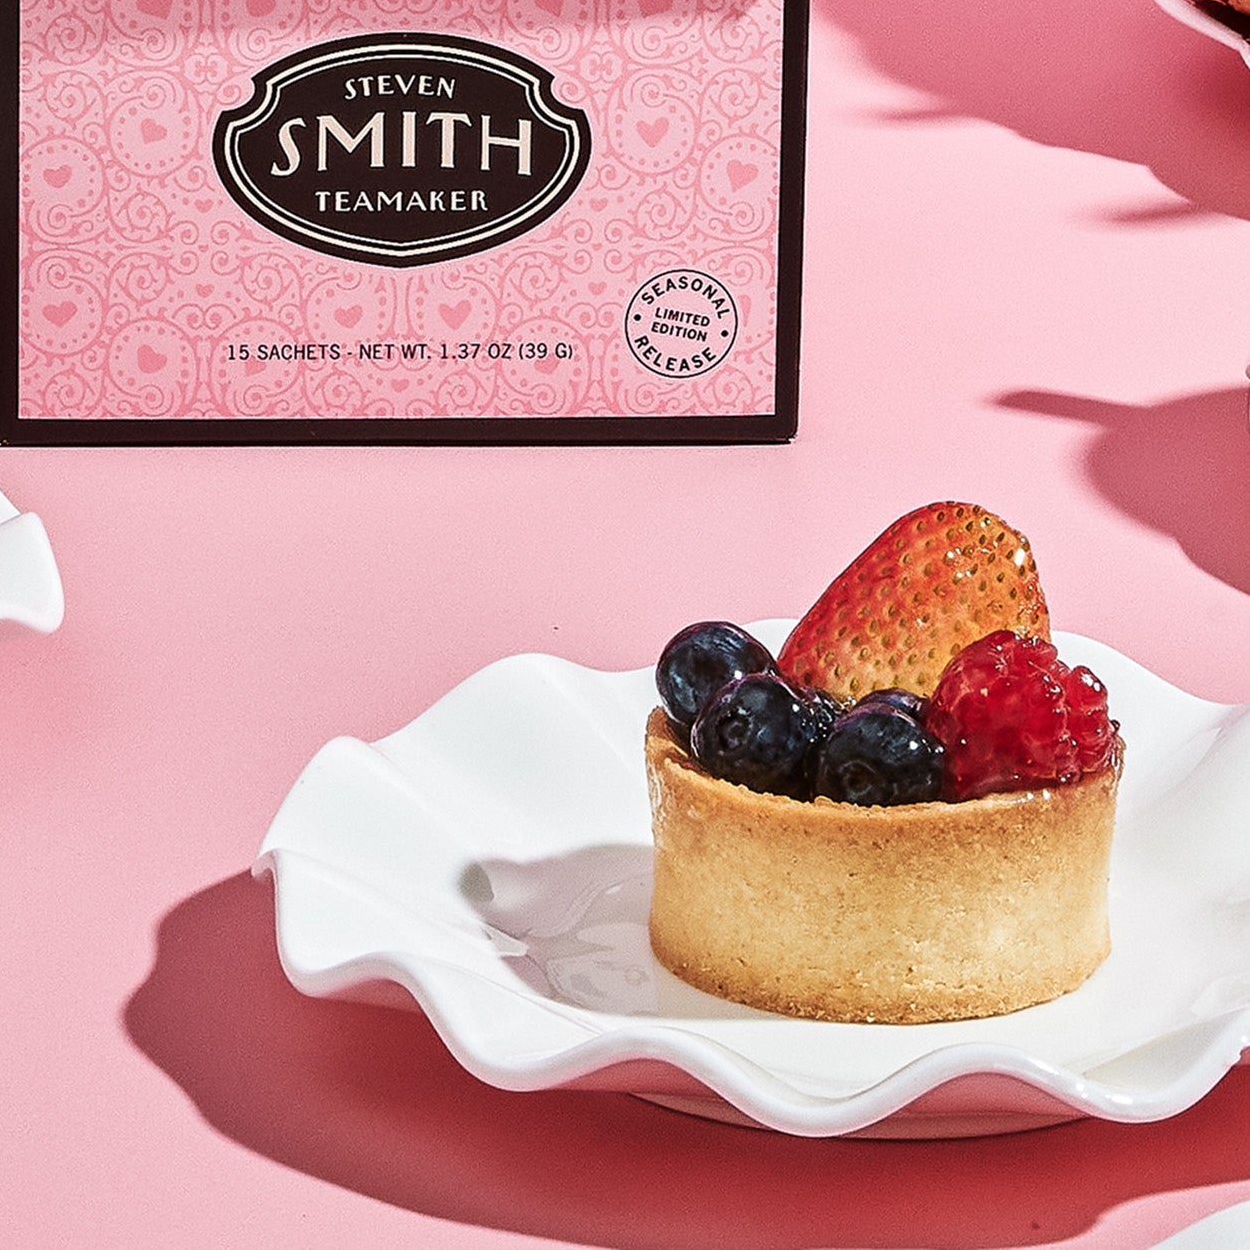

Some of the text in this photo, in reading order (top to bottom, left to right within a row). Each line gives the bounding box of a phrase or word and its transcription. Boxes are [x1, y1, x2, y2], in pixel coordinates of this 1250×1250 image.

[344, 74, 456, 100] STEVEN
[270, 111, 532, 176] SMITH
[315, 190, 489, 212] TEAMAKER
[641, 276, 730, 319] SEASONAL
[655, 307, 710, 327] LIMITED
[651, 321, 708, 342] EDITION
[227, 344, 250, 361] 15
[257, 344, 341, 361] SACHETS
[358, 343, 393, 360] NET
[401, 343, 432, 360] WT.
[440, 343, 481, 360] 1.37
[487, 343, 512, 360] OZ
[518, 342, 548, 361] (39
[554, 342, 574, 361] G)
[634, 335, 717, 371] RELEASE
